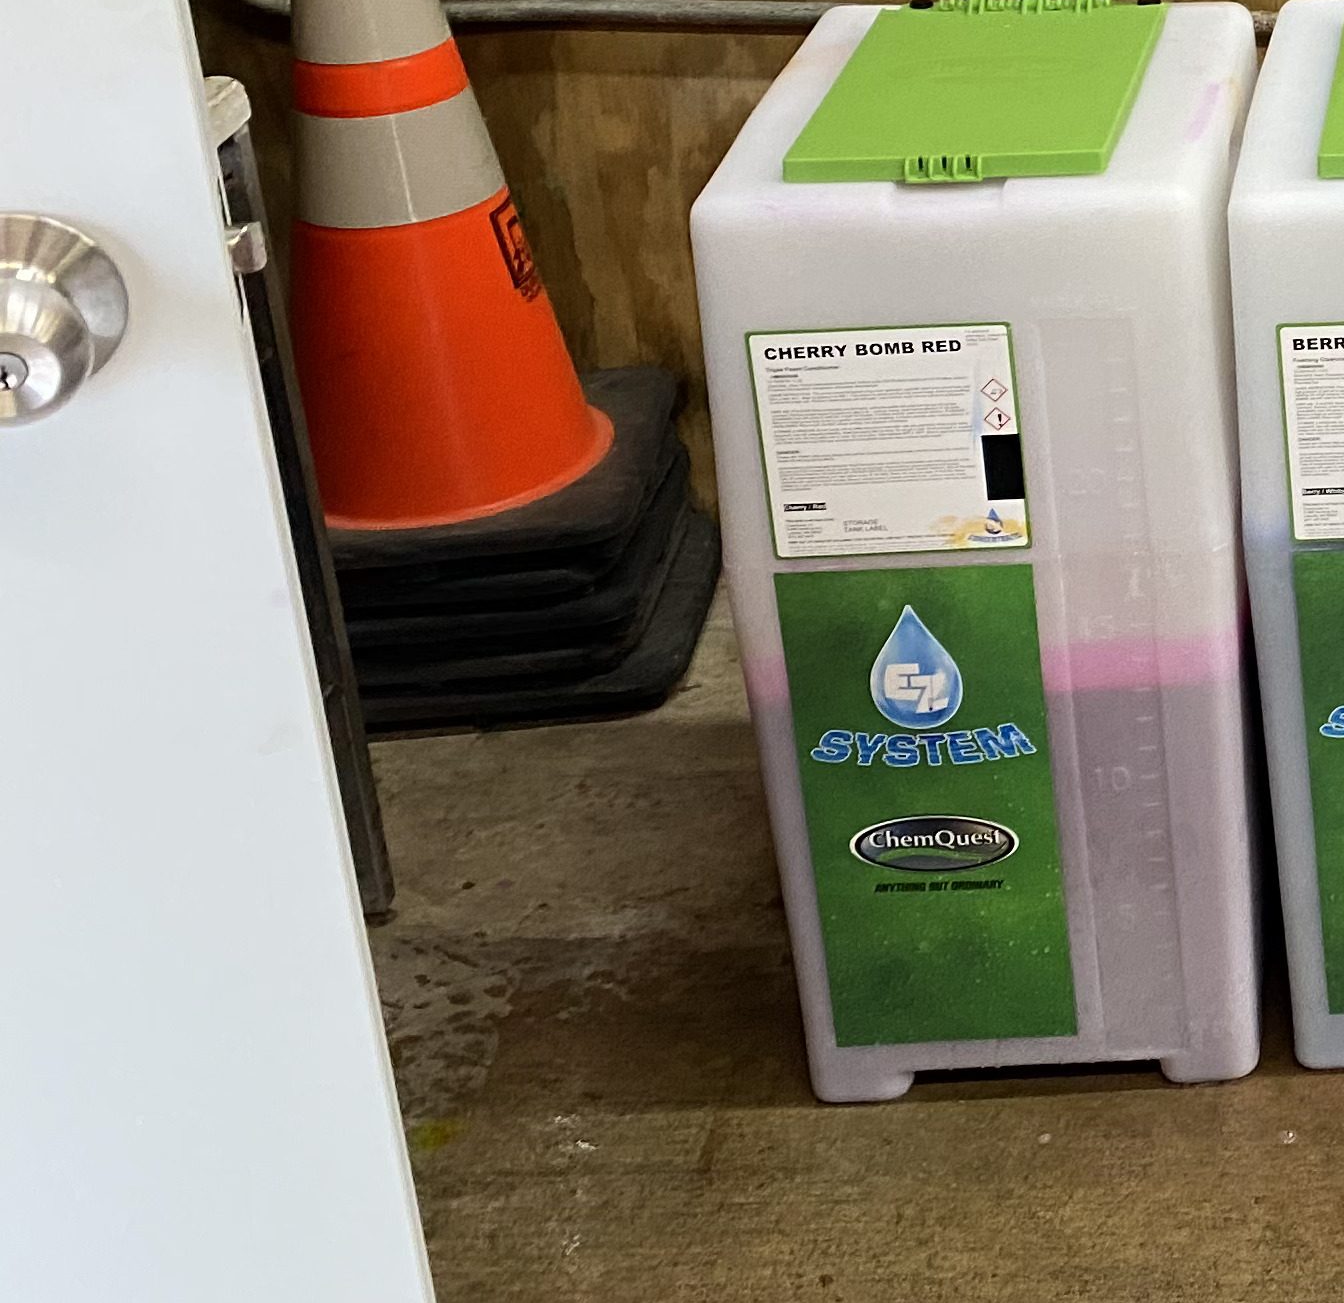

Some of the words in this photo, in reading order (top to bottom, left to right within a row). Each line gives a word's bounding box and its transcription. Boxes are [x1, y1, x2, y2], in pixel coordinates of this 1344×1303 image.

[764, 344, 848, 361] CHERRY
[855, 341, 915, 357] BOMB
[922, 338, 962, 354] RED
[884, 662, 949, 714] EZ
[810, 722, 1037, 768] SYSTEM
[1094, 765, 1132, 792] 10
[869, 828, 1004, 852] ChemQuest
